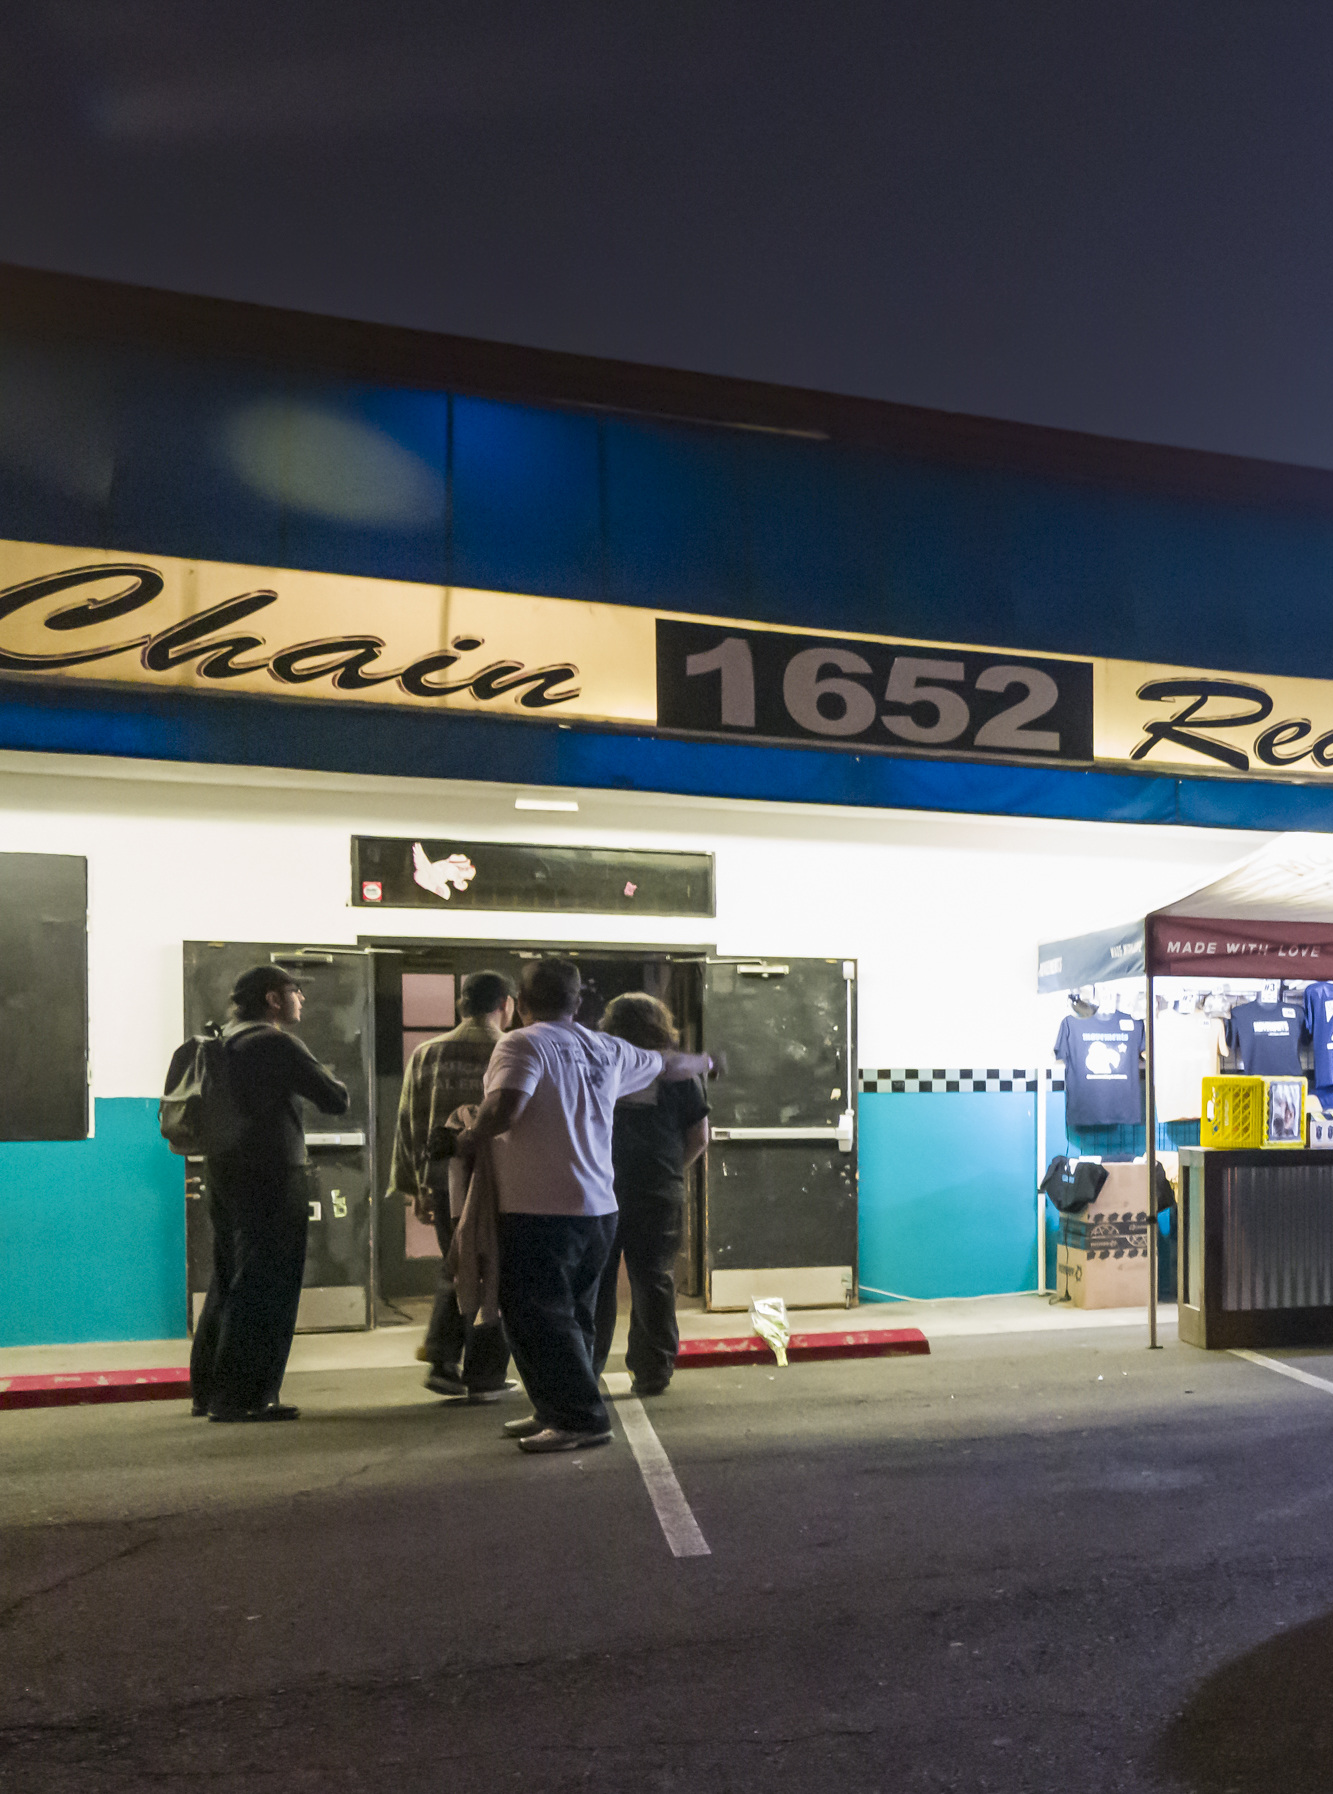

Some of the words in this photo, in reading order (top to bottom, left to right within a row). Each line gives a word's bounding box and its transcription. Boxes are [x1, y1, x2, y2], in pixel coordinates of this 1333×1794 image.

[0, 563, 583, 708] Chain
[686, 637, 1061, 752] 1652
[1166, 941, 1217, 954] MADE
[1226, 943, 1269, 957] WITH
[1278, 944, 1321, 958] LOVE
